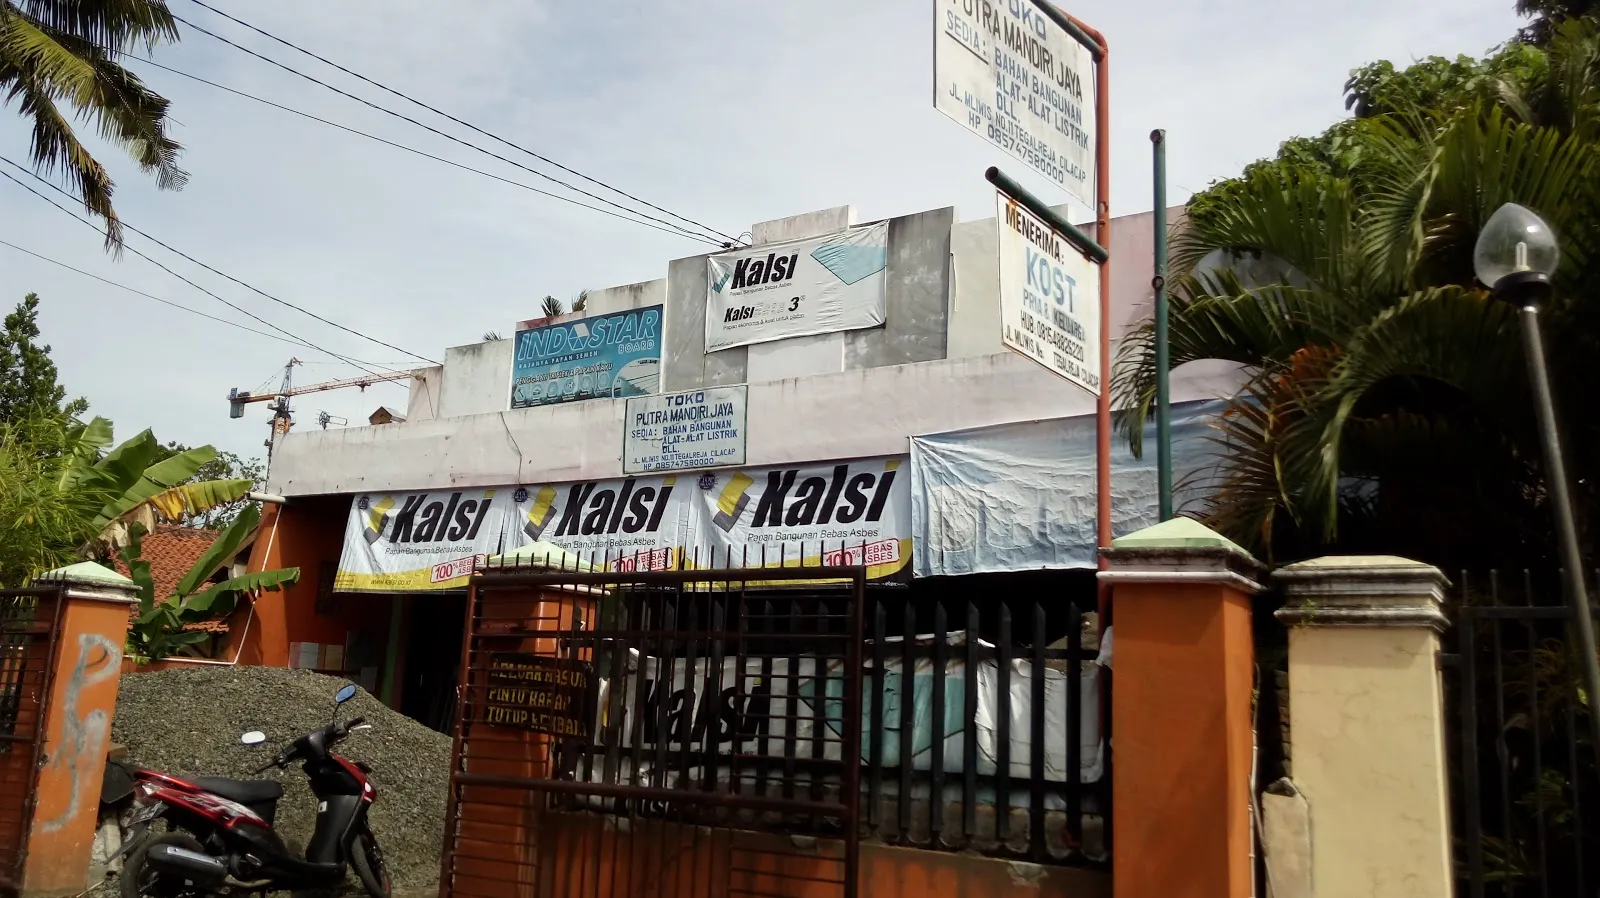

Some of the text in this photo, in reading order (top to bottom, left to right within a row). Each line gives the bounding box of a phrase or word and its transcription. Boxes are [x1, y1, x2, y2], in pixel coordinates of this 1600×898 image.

[947, 9, 986, 56] SEDIA:
[1000, 0, 1046, 41] OKO
[953, 0, 1083, 103] UTRA MANDIRI JAYA
[995, 47, 1082, 126] BAHAN BANGUNAN
[996, 91, 1020, 123] DLL.
[996, 71, 1088, 151] ALAT-ALAT LISTRIK
[949, 82, 963, 103] JL.
[1013, 124, 1056, 164] TEGALREJA
[1060, 156, 1086, 183] CILACAP
[969, 111, 1063, 183] HP 085747580000
[731, 250, 800, 289] Kalsi
[1026, 247, 1077, 313] KOST
[1023, 288, 1043, 316] PRIA
[551, 355, 573, 364] PAPAN
[576, 350, 598, 360] SEMEN
[618, 340, 655, 355] BOARD
[665, 392, 705, 407] TOKO
[636, 402, 734, 426] PUTRA MANDIRI JAYA
[662, 424, 687, 436] BAHAN
[690, 420, 732, 433] BANGUNAN
[707, 428, 738, 440] LISTRIK
[644, 457, 714, 471] HP 085747580000
[675, 451, 708, 460] TEGALREJA
[711, 448, 736, 457] CILACAP
[751, 460, 902, 528] Kalsi
[389, 489, 496, 543] Kalsi
[554, 476, 677, 537] Kalsi
[552, 541, 571, 550] pan
[609, 539, 631, 547] Bebas
[632, 538, 655, 546] Asbes
[748, 528, 878, 544] Papan Bangunan Bebas Asbes
[385, 547, 404, 555] Papan
[453, 545, 473, 553] Asbes
[459, 556, 481, 568] BEBS
[864, 551, 893, 564] SBES
[488, 687, 525, 703] PINTU
[487, 706, 528, 724] TUTUP
